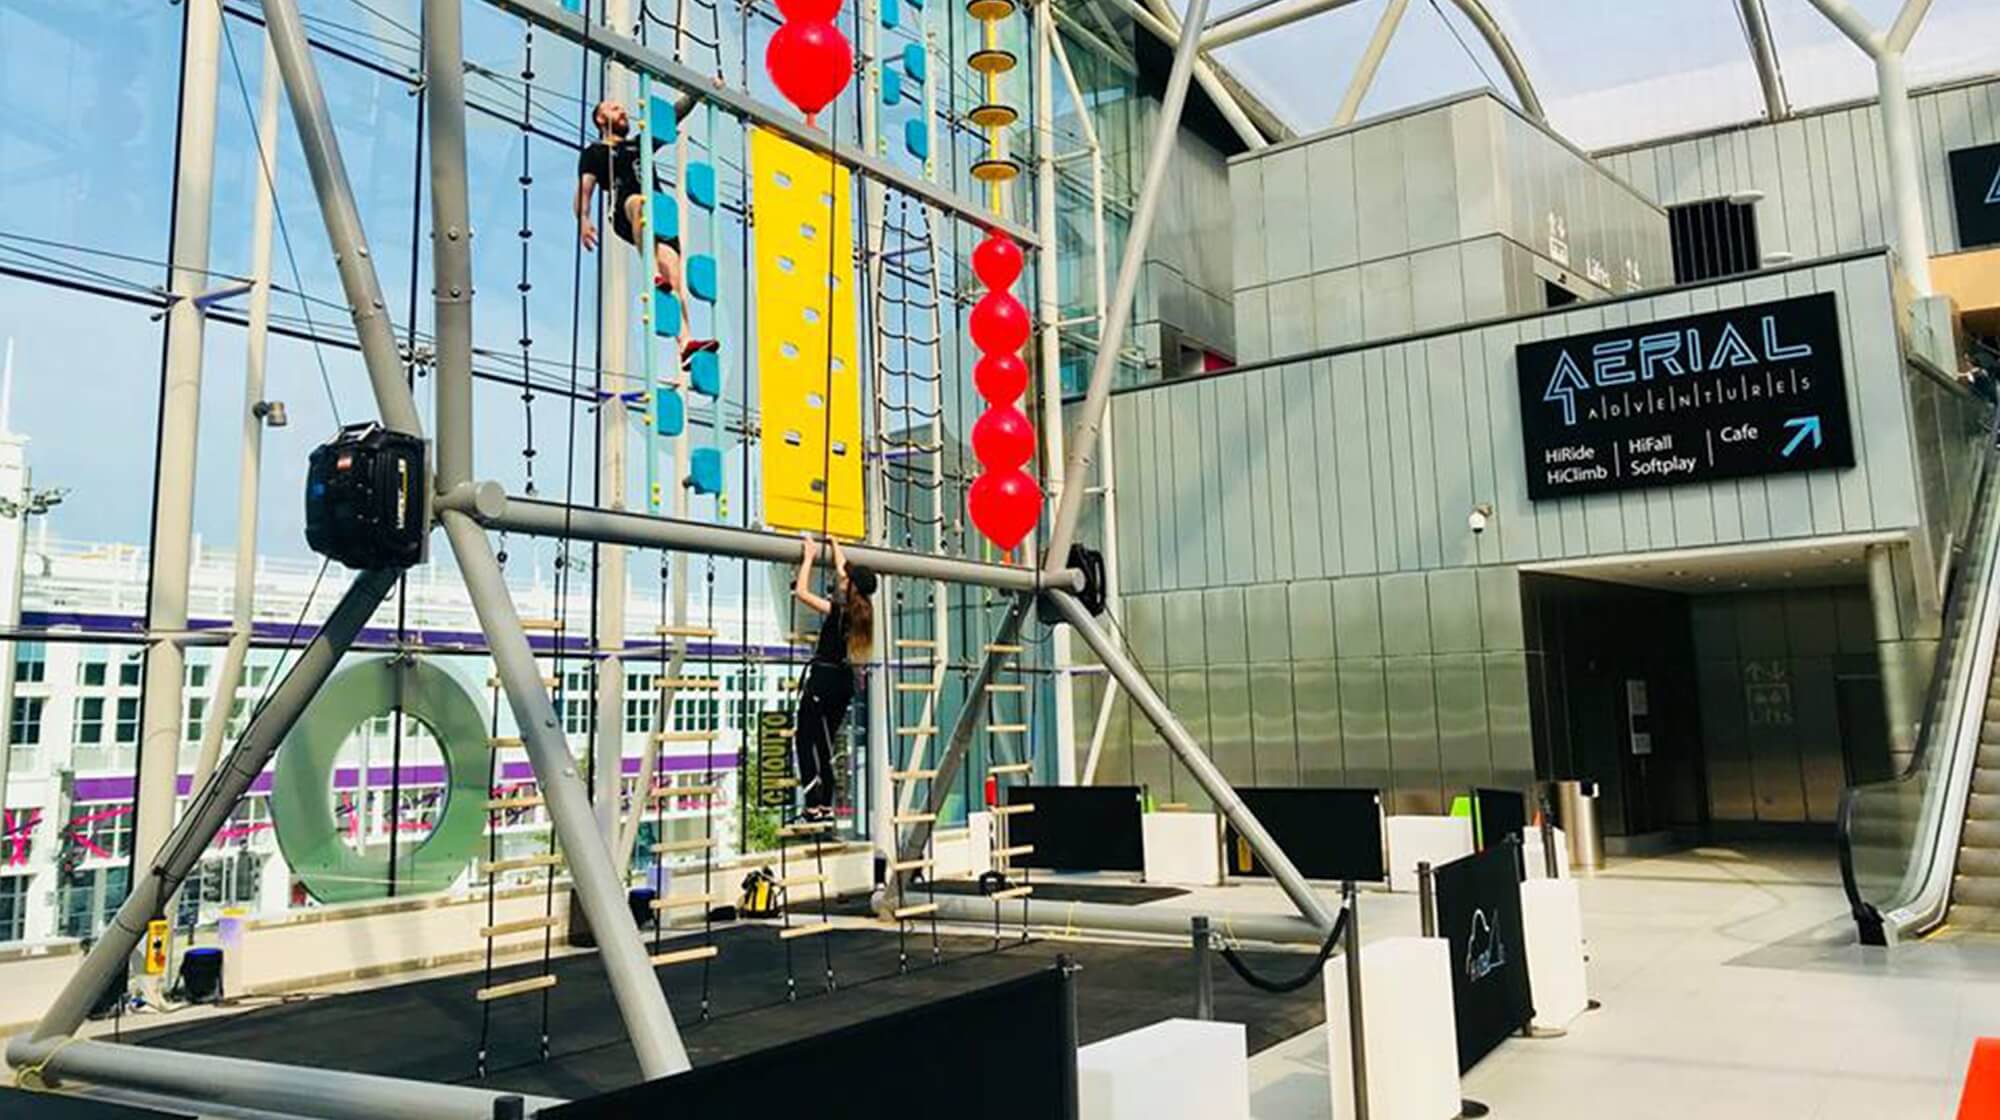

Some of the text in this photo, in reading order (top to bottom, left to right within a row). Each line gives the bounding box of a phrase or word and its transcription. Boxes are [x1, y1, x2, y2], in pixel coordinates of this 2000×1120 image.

[1544, 316, 1813, 426] AERIAL
[1588, 376, 1811, 419] ADVENTURES
[1628, 434, 1673, 455] HiFall
[1720, 425, 1759, 444] Cafe
[1545, 445, 1596, 464] HiRide
[1547, 465, 1608, 485] HiClimb
[1630, 454, 1698, 477] Softplay
